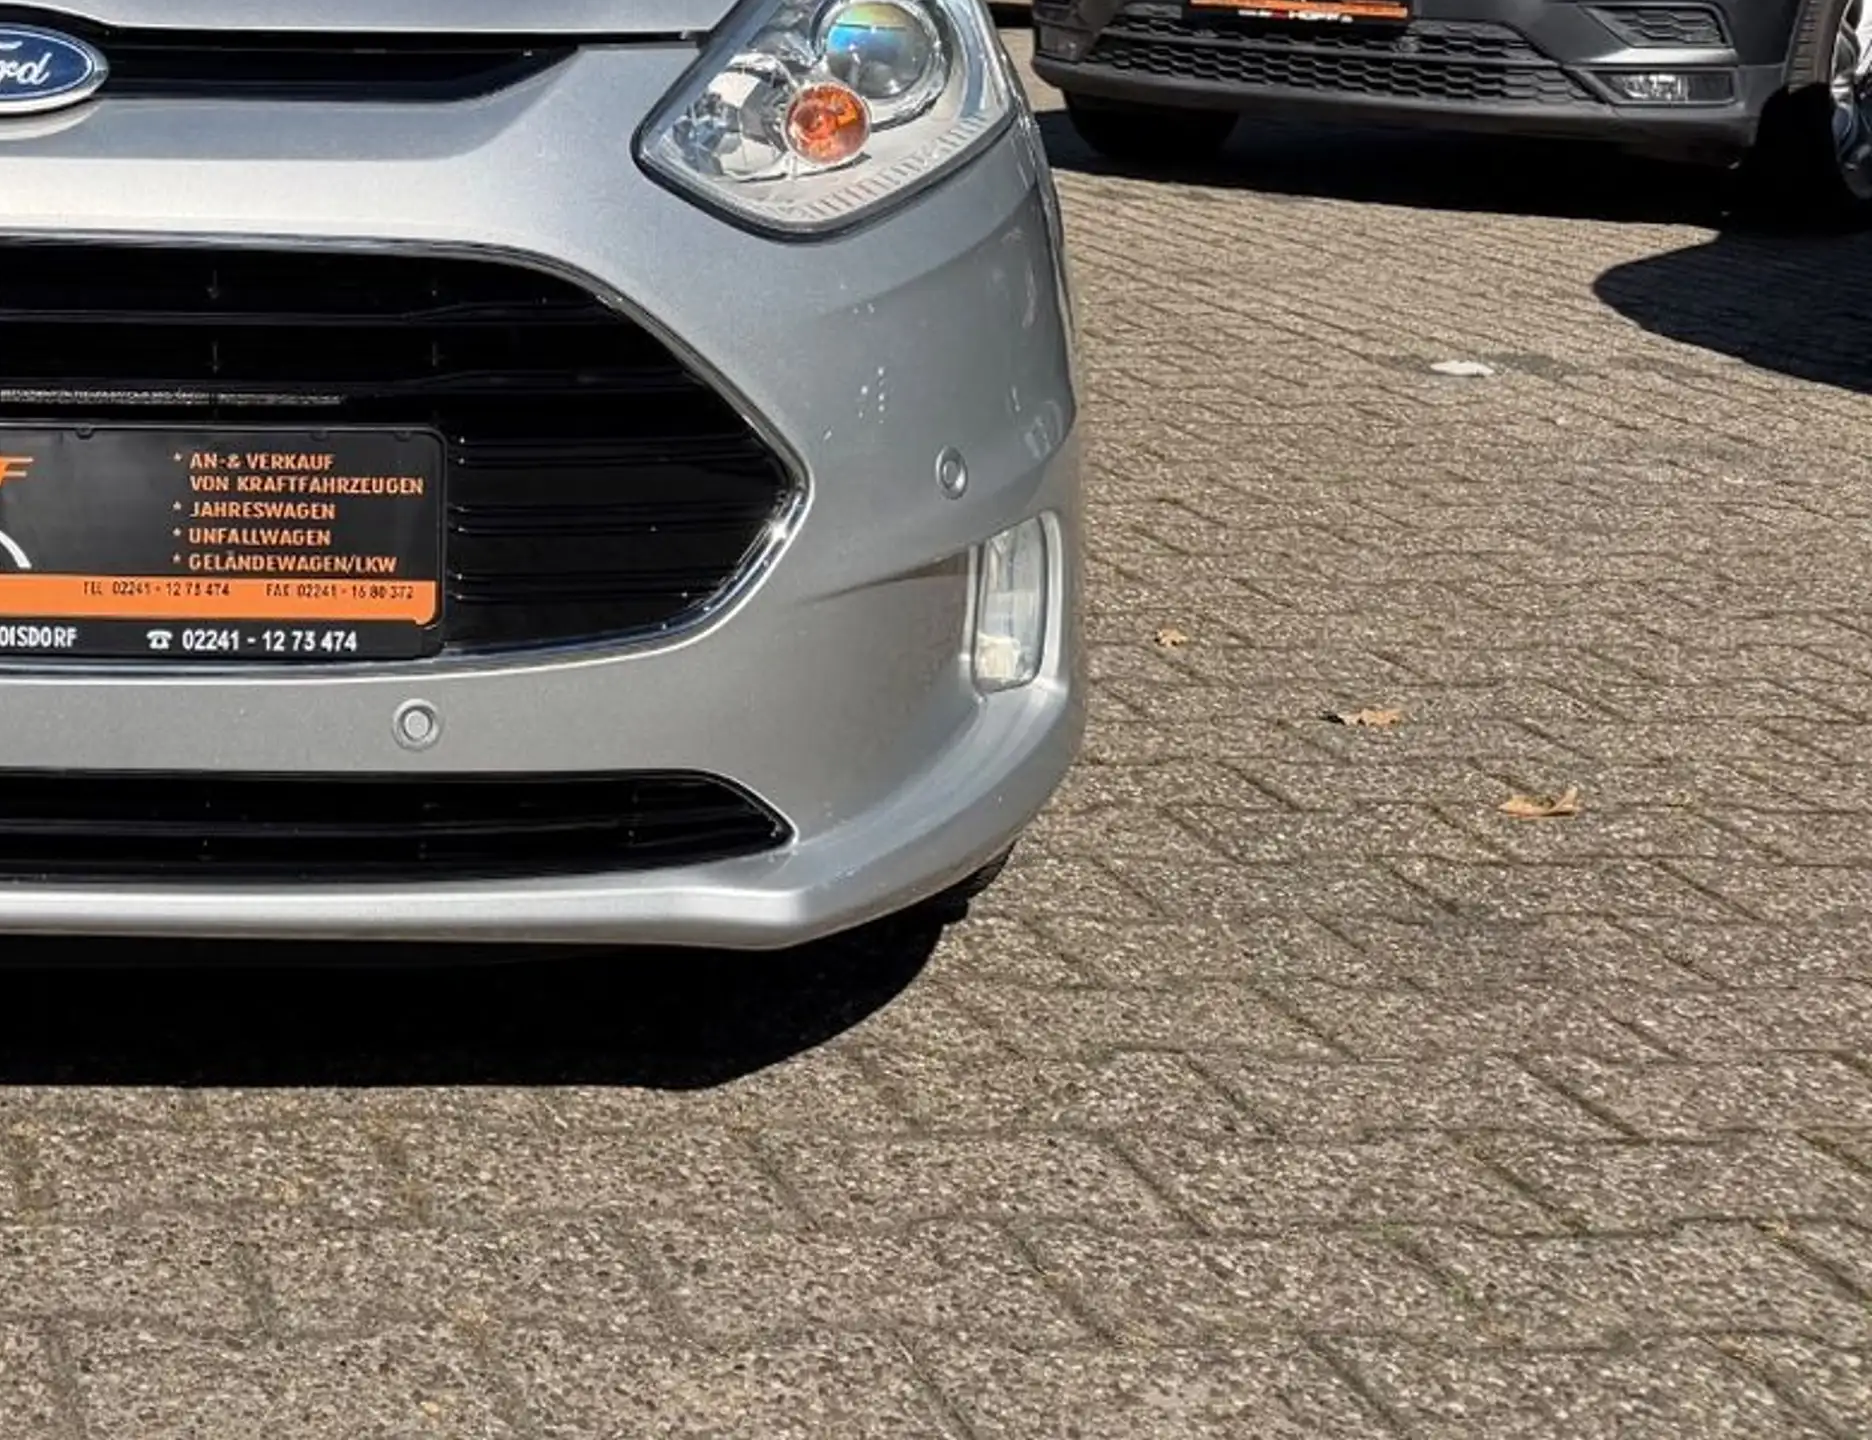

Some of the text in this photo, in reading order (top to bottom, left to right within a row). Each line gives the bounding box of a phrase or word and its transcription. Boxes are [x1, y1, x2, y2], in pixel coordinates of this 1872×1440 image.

[246, 453, 335, 471] VERKAUF
[189, 475, 424, 495] VON KRAFTFAHRZEUGEN
[189, 501, 336, 520] JAHRESWAGEN
[188, 527, 332, 546] UNFALLWAGEN
[188, 550, 397, 574] GELÄNDEWAGEN/LKW
[112, 581, 151, 595] 02241
[166, 582, 181, 596] 12
[204, 583, 230, 597] 474
[297, 584, 337, 599] 02241
[182, 629, 240, 651] 02241
[262, 630, 286, 651] 12
[320, 630, 358, 652] 474
